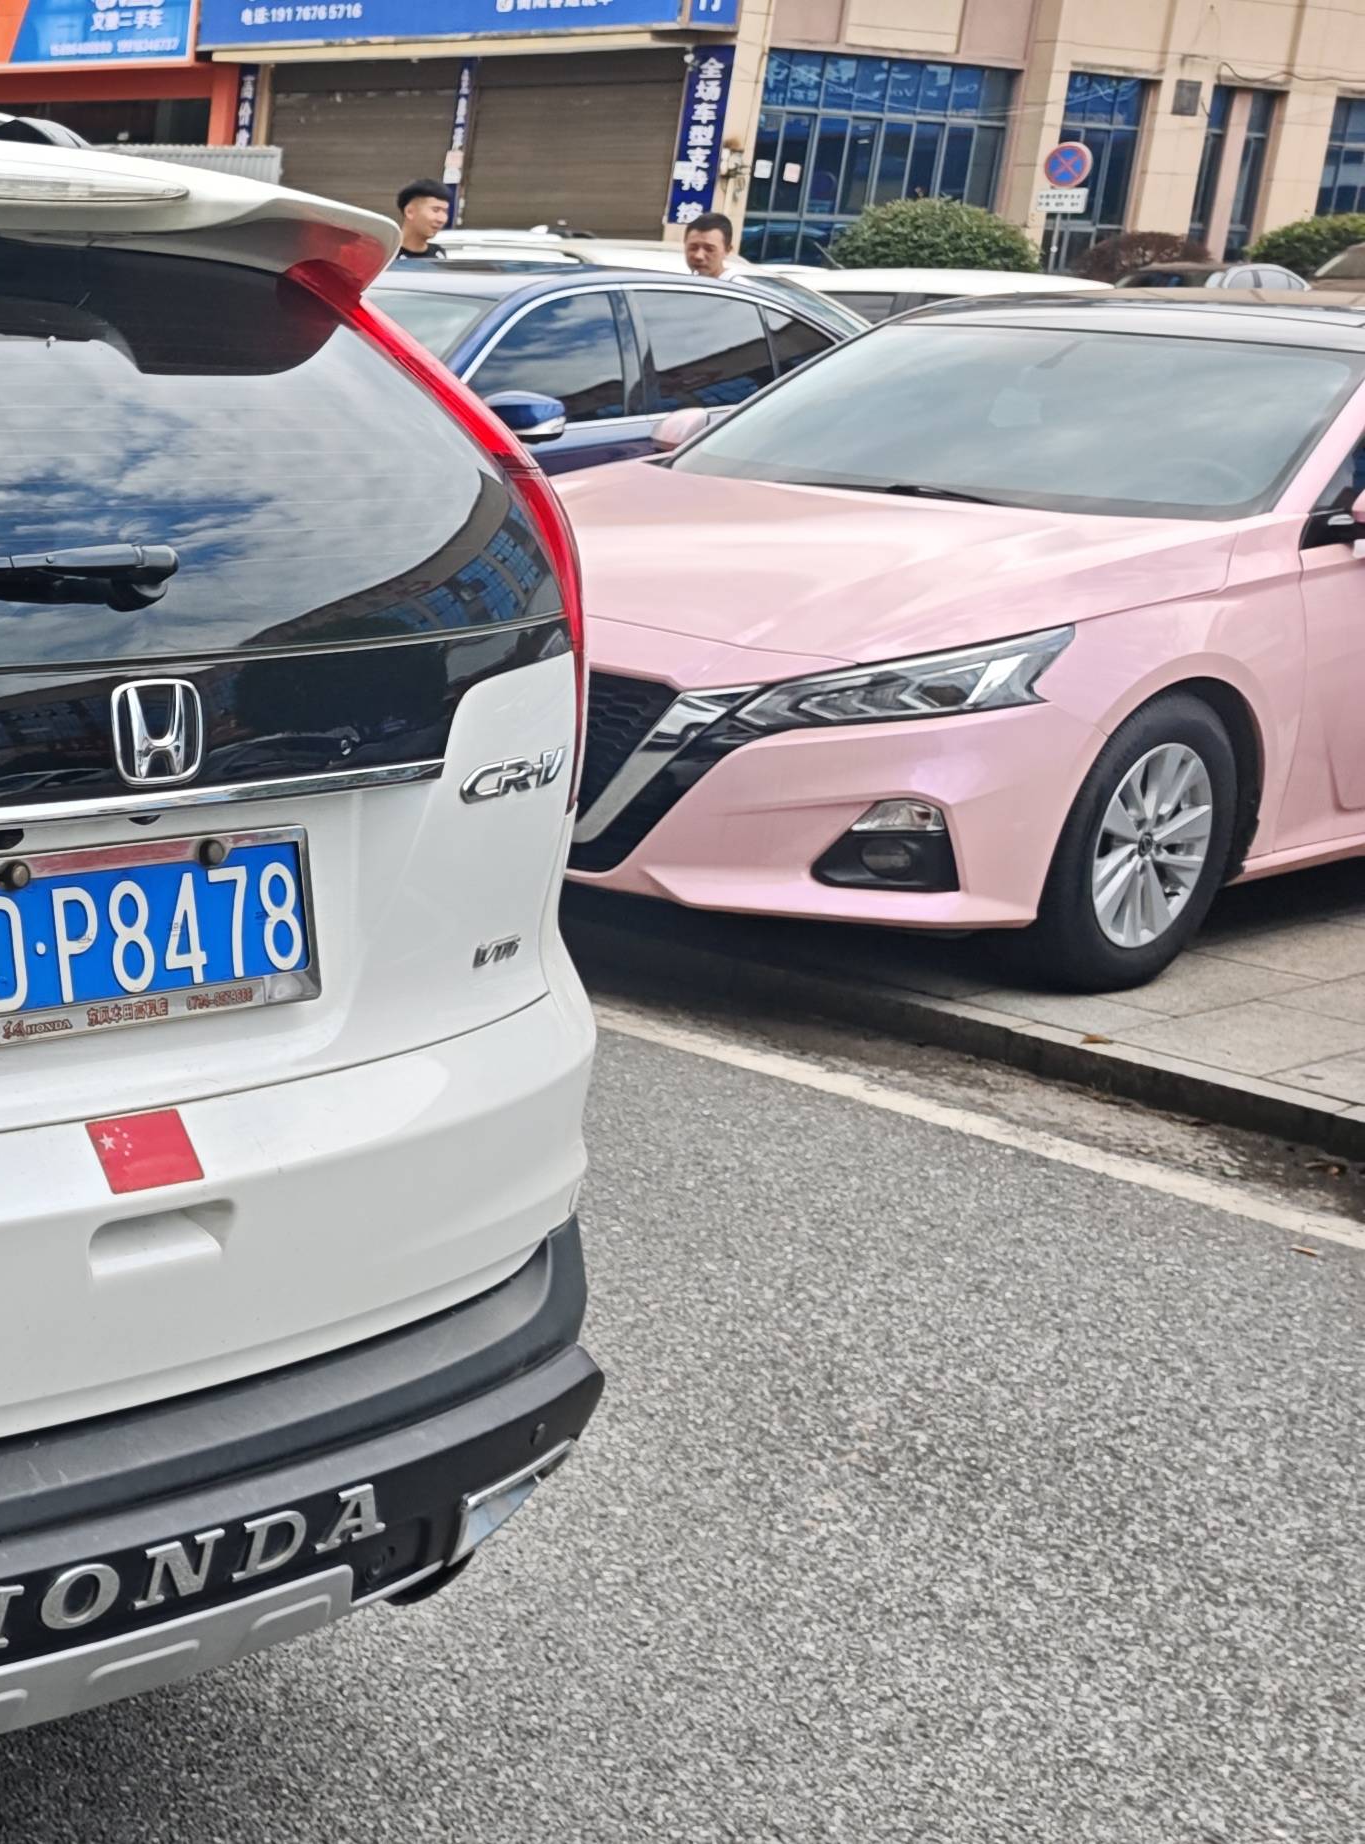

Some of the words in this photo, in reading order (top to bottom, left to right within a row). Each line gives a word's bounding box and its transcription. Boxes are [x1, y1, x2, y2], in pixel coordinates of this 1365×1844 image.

[678, 57, 726, 192] 全场车型支持
[459, 746, 567, 804] CR-V
